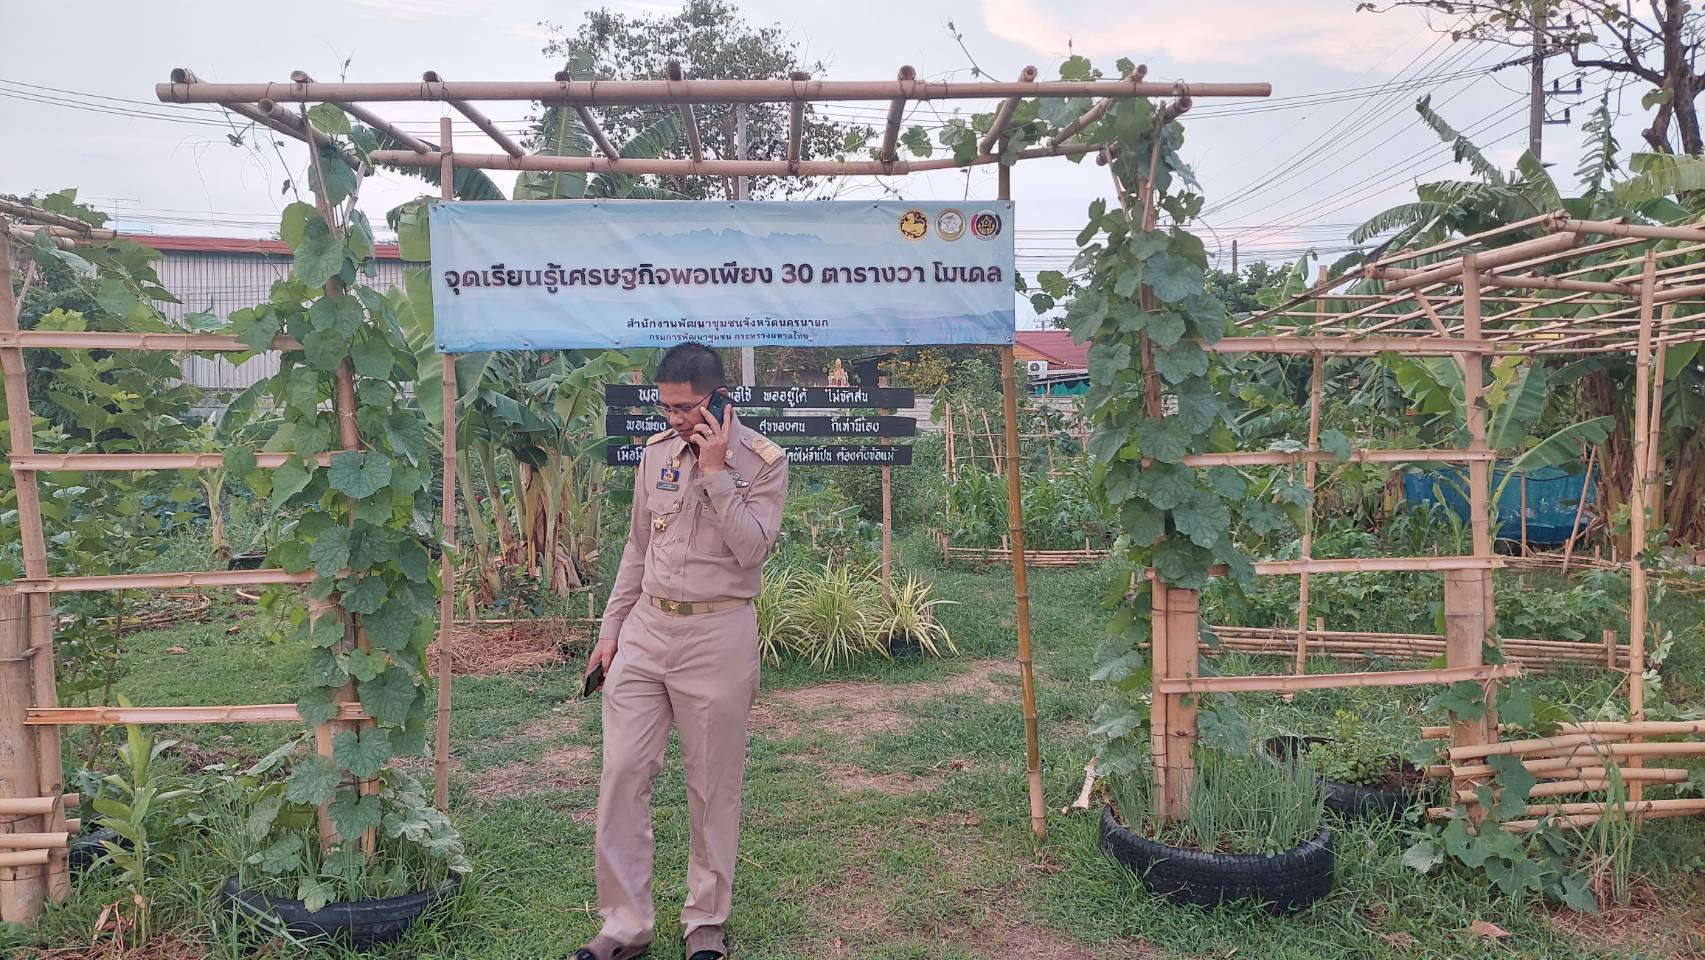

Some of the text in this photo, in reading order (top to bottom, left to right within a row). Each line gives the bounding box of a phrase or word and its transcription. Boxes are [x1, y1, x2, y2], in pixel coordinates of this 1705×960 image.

[444, 261, 1002, 295] จุดเรียนรู้เศรษฐกิจพอเพียง 30 ตารางวา โมเดล
[627, 316, 829, 332] สำนักงานพัฒนาชุมชนจังหวัดนครนายก
[649, 331, 809, 343] กรมการพัฒนาชุมชน กระทรวงมหาดไทย
